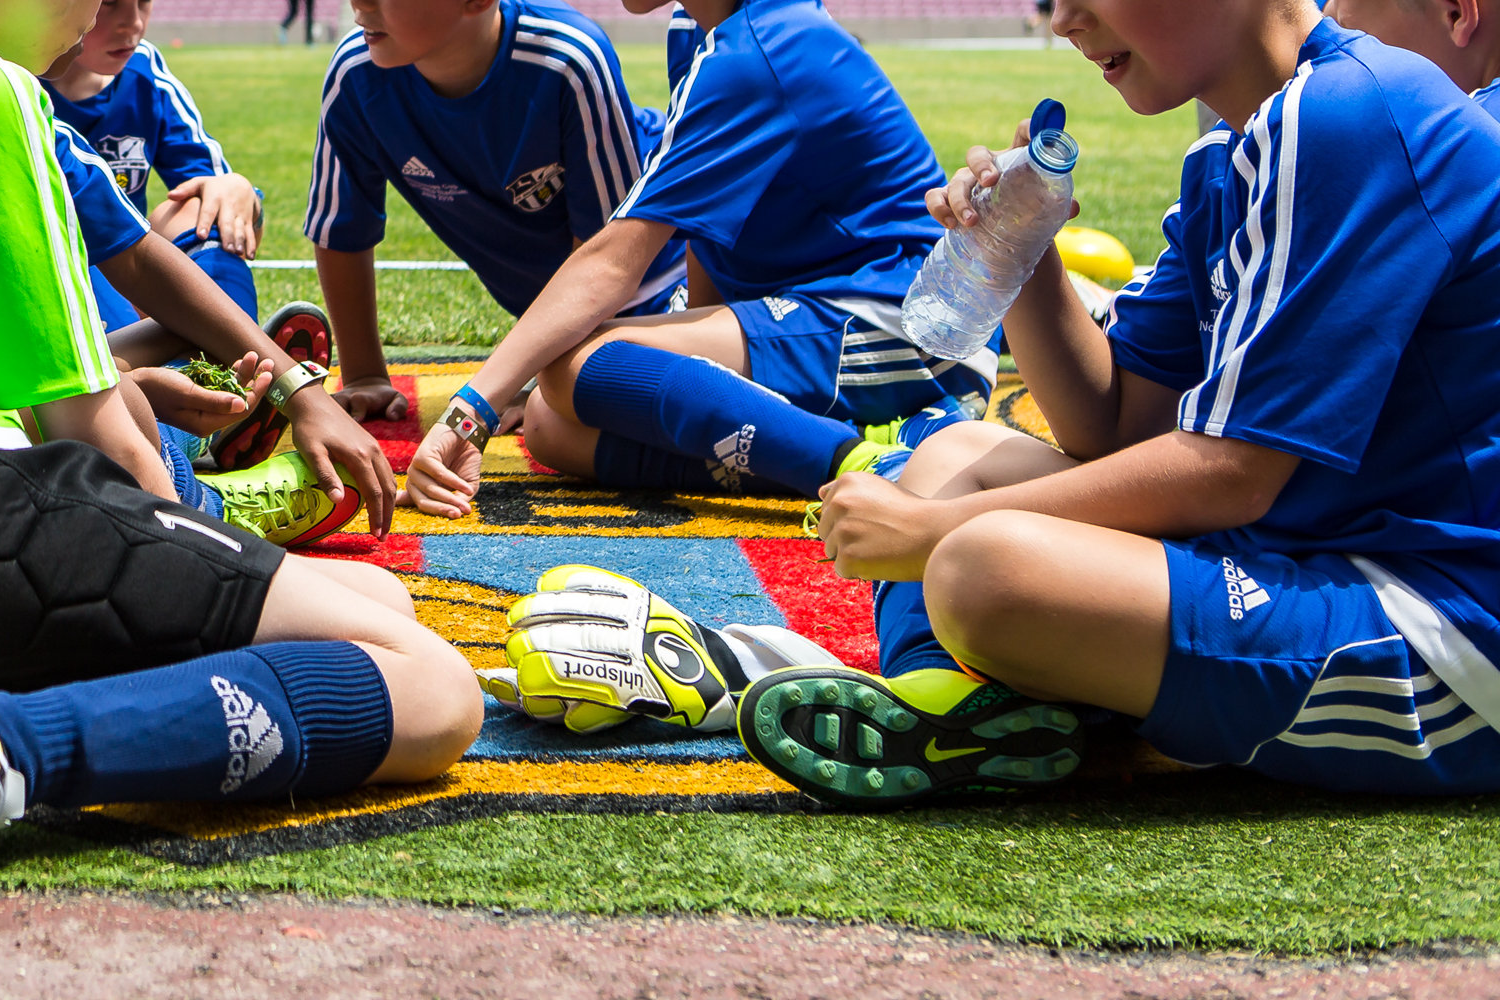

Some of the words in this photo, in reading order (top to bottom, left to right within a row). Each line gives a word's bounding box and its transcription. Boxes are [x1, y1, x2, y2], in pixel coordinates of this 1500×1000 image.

[154, 509, 242, 553] 1
[1222, 556, 1244, 621] adidas
[563, 661, 644, 691] uhlsport
[210, 675, 249, 795] adidas
